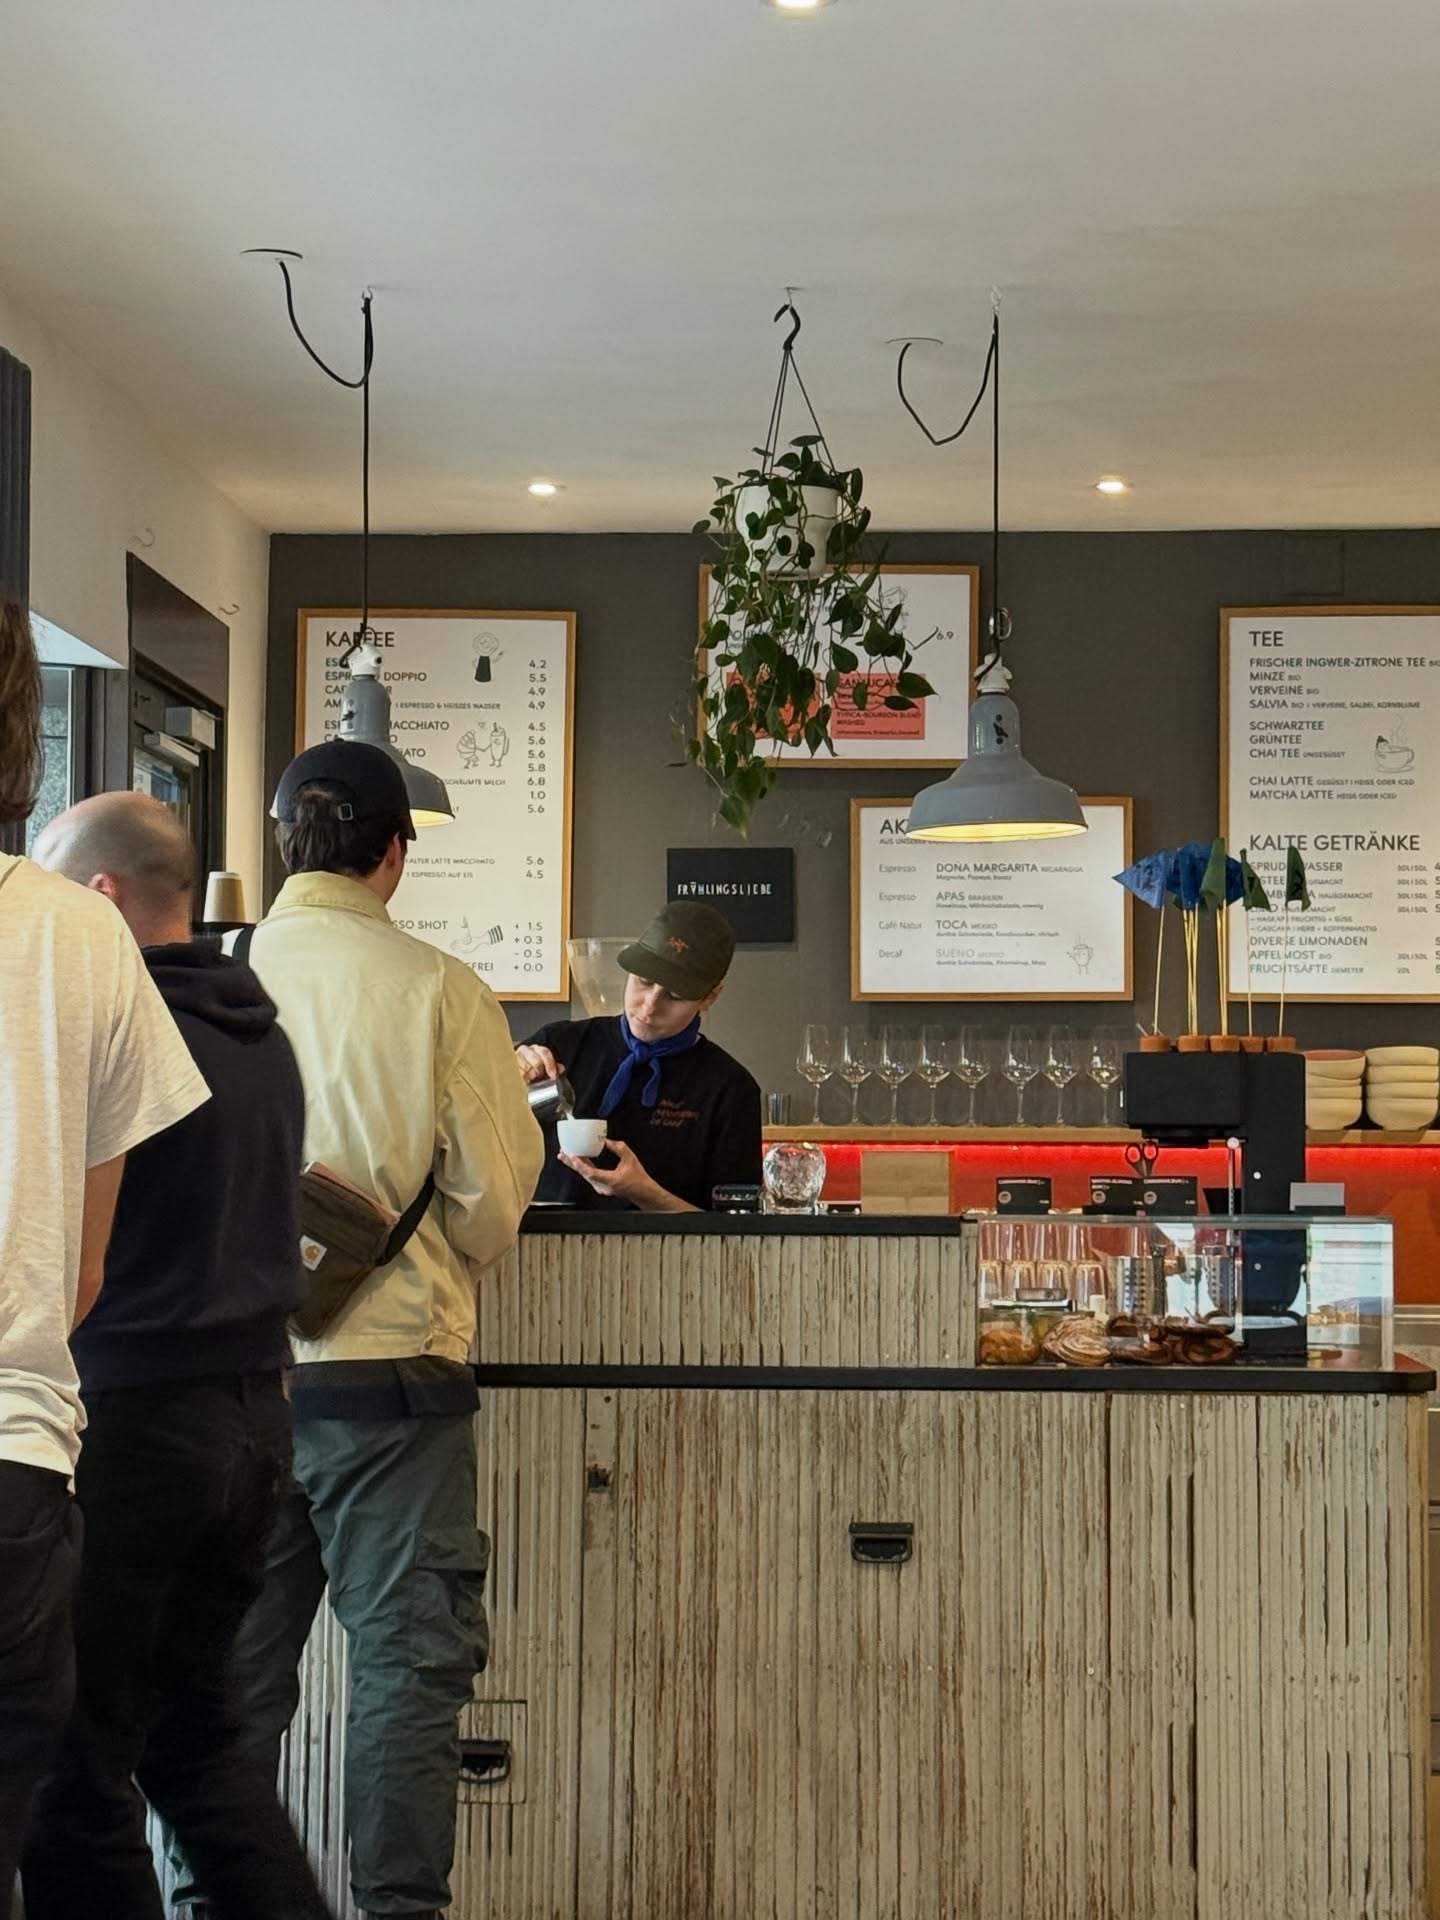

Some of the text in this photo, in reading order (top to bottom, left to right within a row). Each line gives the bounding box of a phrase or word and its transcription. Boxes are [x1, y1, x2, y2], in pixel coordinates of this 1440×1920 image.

[937, 631, 954, 640] 6.9
[1249, 631, 1284, 647] TEE
[529, 660, 547, 669] 4.2
[1249, 658, 1303, 667] FRISCHER
[1305, 657, 1403, 667] INGWER-ZITRONE
[1406, 657, 1426, 667] TEE
[384, 672, 427, 681] DOPPIO
[528, 673, 547, 682] 5.5
[1249, 672, 1285, 681] MINZE
[528, 687, 546, 696] 4.9
[1249, 686, 1303, 695] VERVEINE
[528, 701, 546, 710] 4.9
[1249, 700, 1288, 709] SALVIA
[528, 722, 546, 731] 4.5
[1249, 721, 1325, 730] SCHWARZTEE
[528, 736, 546, 745] 5.6
[1249, 733, 1302, 744] GRÜNTEE
[528, 750, 546, 759] 5.6
[1249, 748, 1277, 758] CHAI
[1281, 748, 1300, 758] TEE
[528, 763, 546, 772] 5.8
[527, 777, 546, 786] 6.8
[1249, 776, 1277, 785] CHAI
[1281, 776, 1313, 785] LATTE
[530, 791, 546, 799] 1.0
[1249, 790, 1297, 799] MATCHA
[1300, 790, 1334, 799] LATTE
[528, 804, 544, 813] 5.6
[1250, 831, 1420, 851] KALTE GETRÄNKE
[526, 856, 544, 865] 5.6
[879, 864, 917, 874] Espresso
[973, 863, 1038, 872] MARGARITA
[526, 870, 544, 879] 4.5
[879, 892, 917, 902] Espresso
[936, 892, 965, 901] APAS
[418, 920, 448, 929] SHOT
[936, 920, 968, 929] TOCA
[1250, 936, 1368, 945] DIVERSE LIMONADEN
[879, 949, 902, 959] Decaf
[1249, 950, 1316, 959] APFELMOST
